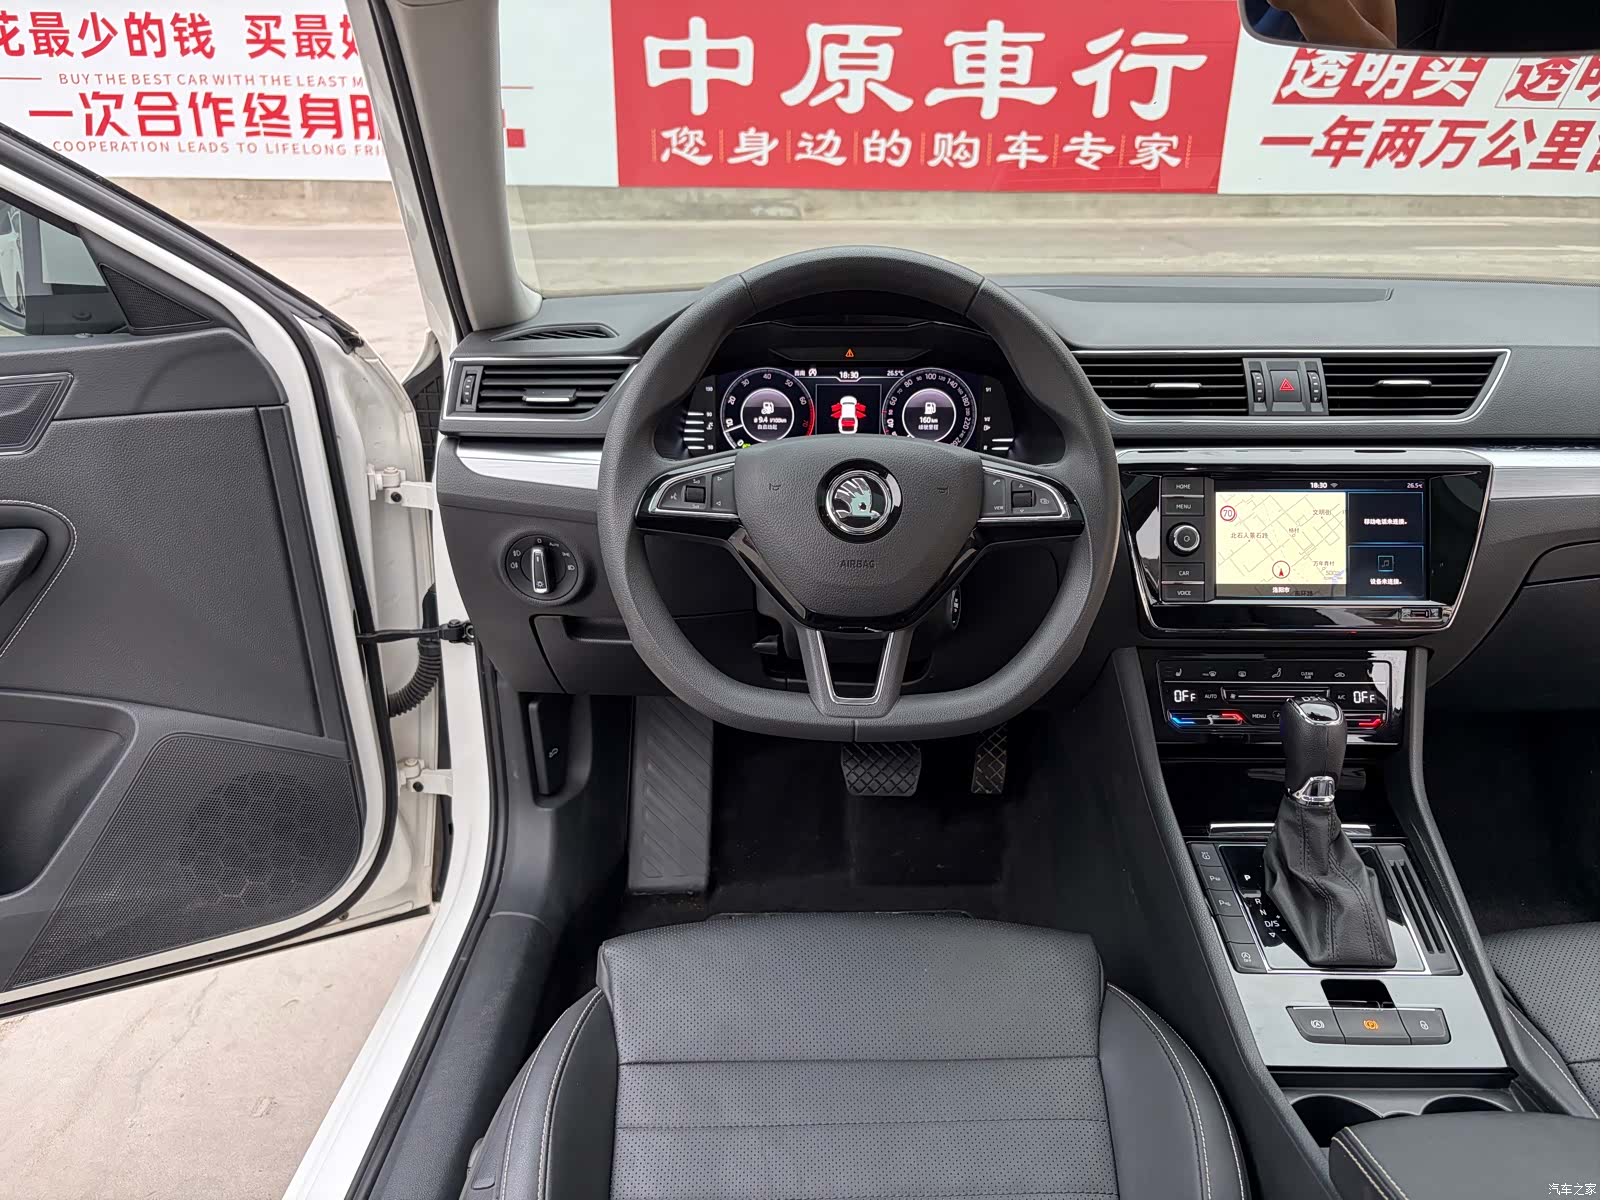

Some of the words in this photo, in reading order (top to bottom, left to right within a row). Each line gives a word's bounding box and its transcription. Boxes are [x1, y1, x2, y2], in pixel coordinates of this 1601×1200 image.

[643, 16, 1208, 121] 中原車行
[59, 73, 90, 85] BUY
[95, 73, 127, 85] THE
[131, 73, 172, 86] BEST
[176, 74, 208, 86] CAR
[212, 74, 255, 86] WITH
[260, 75, 292, 87] THE
[296, 75, 347, 88] LEAST
[53, 140, 170, 153] COOPERATION
[178, 141, 229, 154] LEADS
[236, 142, 258, 154] TO
[265, 143, 347, 156] LIFELONG
[355, 144, 385, 156] FRI
[659, 127, 1181, 171] 您身边的购车专家
[1260, 115, 1600, 173] 一年两万公里
[839, 371, 859, 379] 18:30
[741, 378, 750, 387] 30
[784, 379, 794, 388] 50
[904, 379, 913, 388] 80
[946, 378, 958, 389] 140
[727, 395, 736, 405] 20
[799, 396, 807, 405] 60
[890, 396, 898, 406] 60
[961, 394, 970, 407] 180
[725, 418, 734, 428] 10
[886, 418, 894, 428] 40
[962, 417, 971, 430] 220
[1223, 509, 1233, 518] 70
[839, 559, 876, 569] AIRBAG
